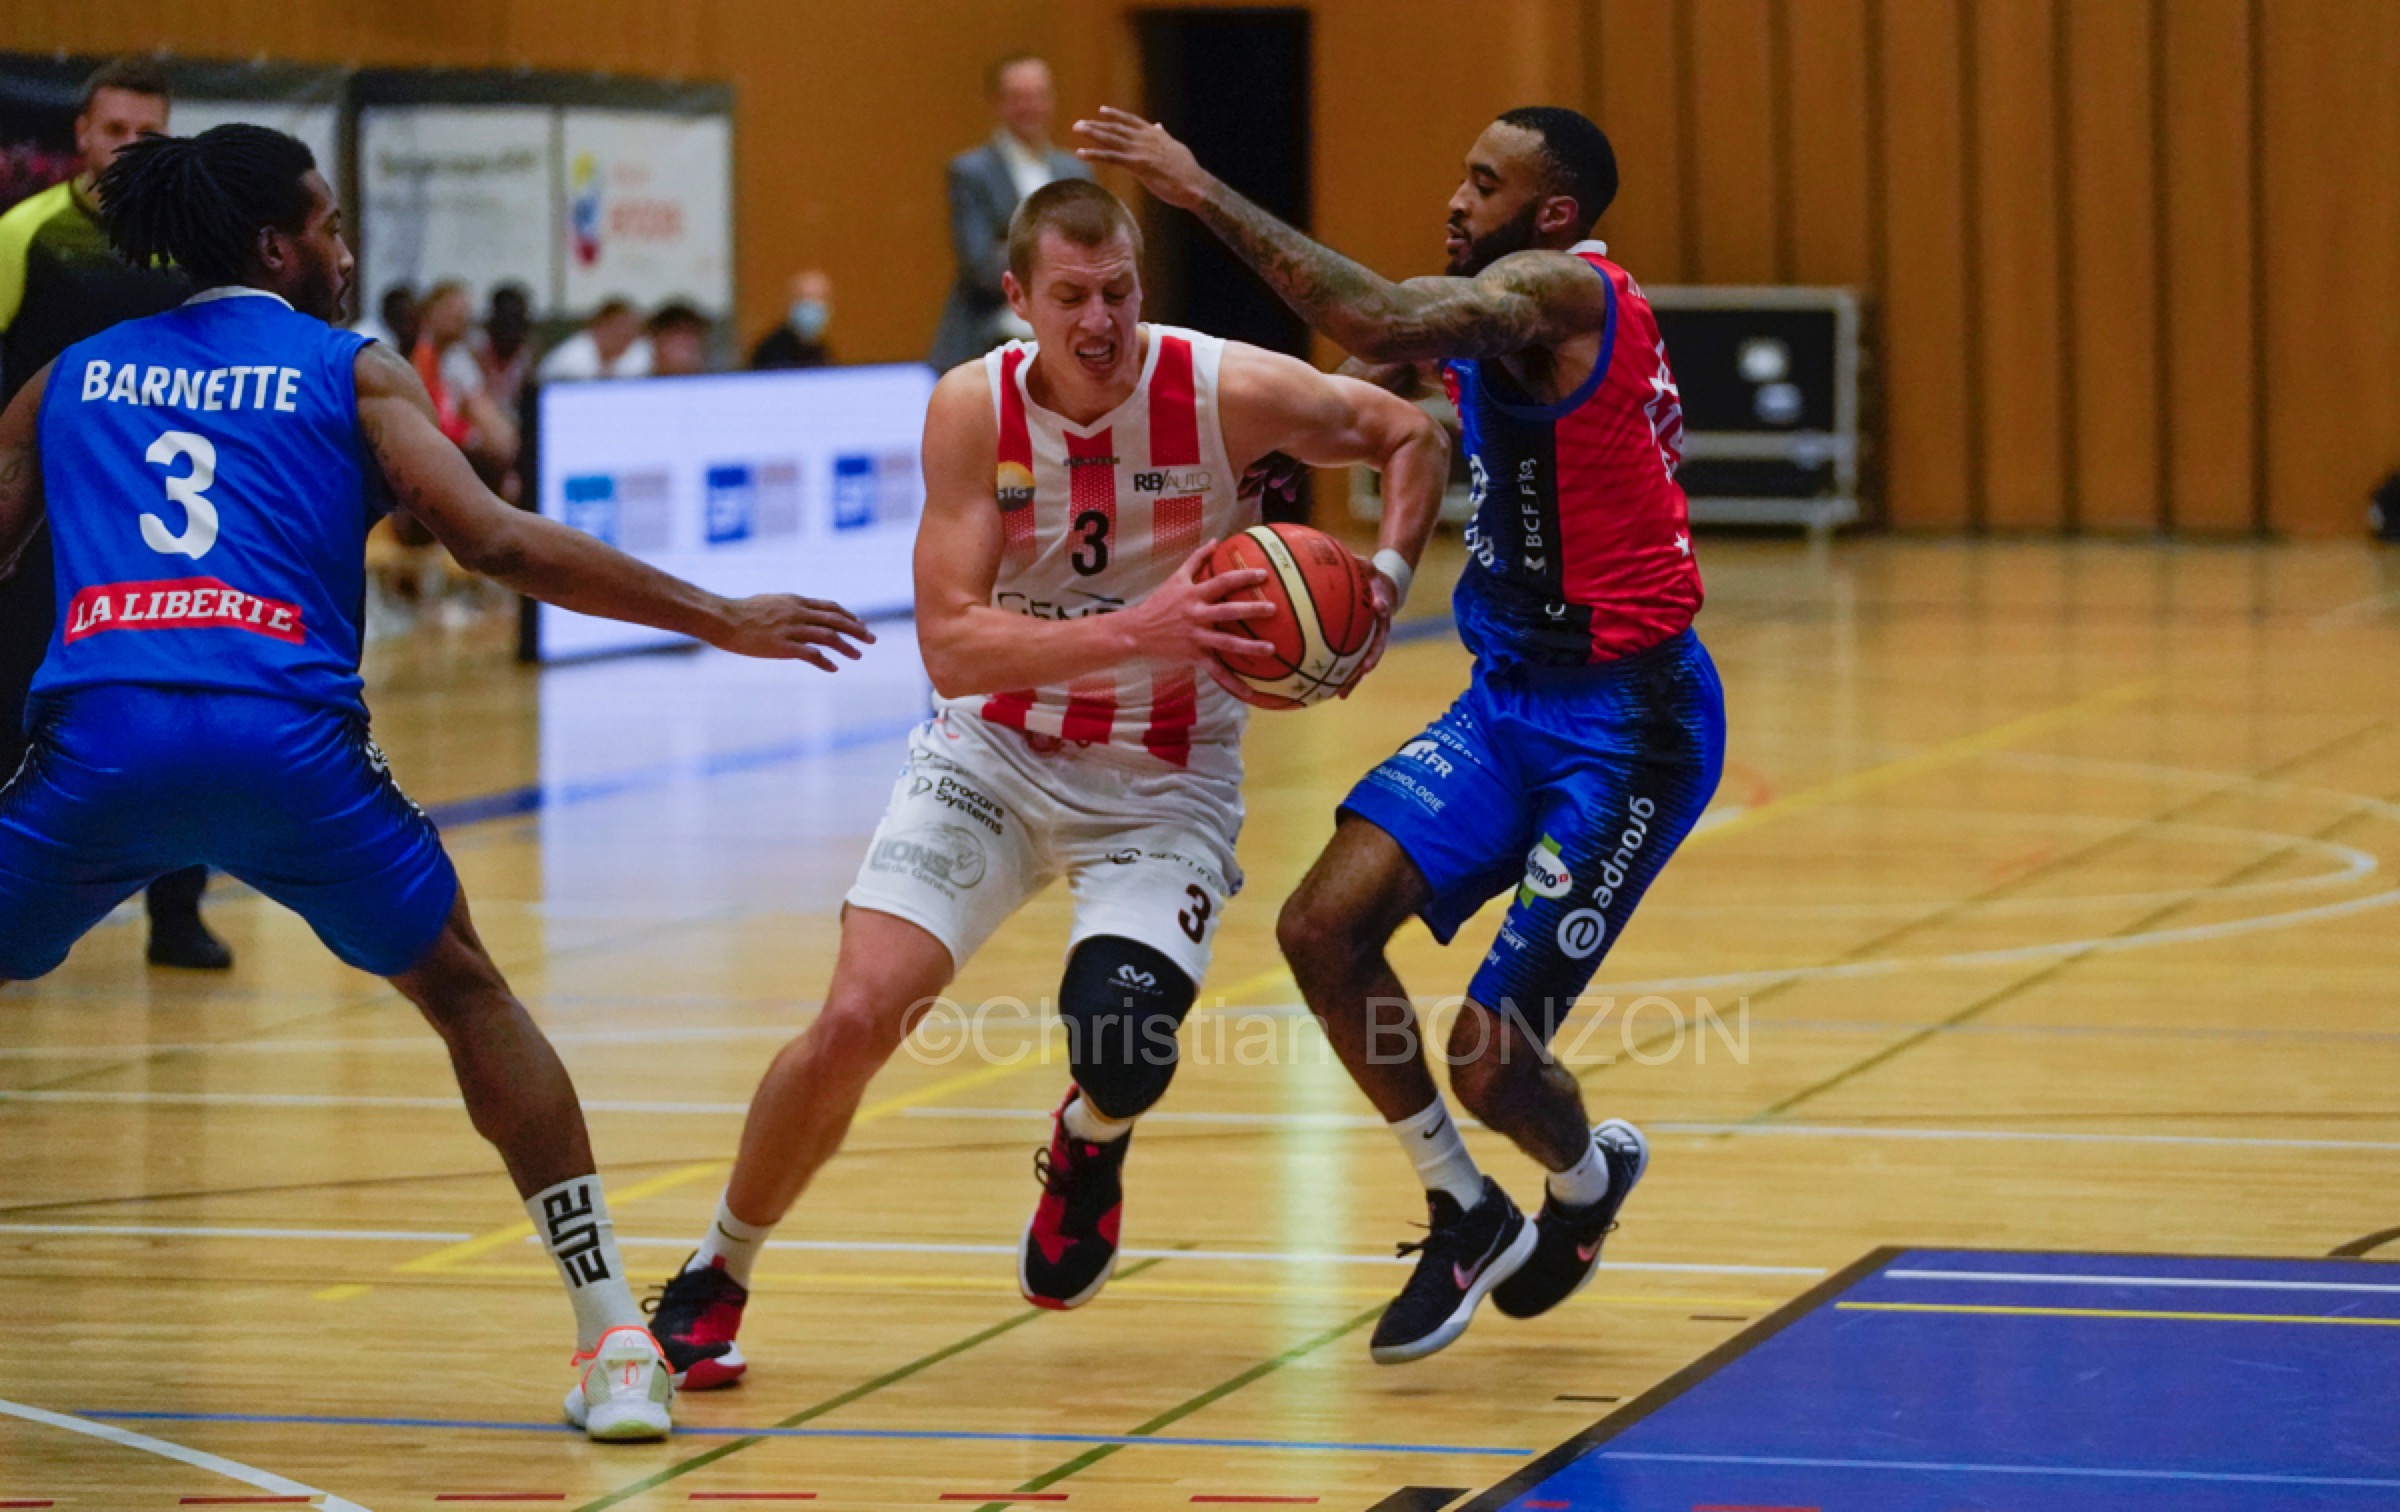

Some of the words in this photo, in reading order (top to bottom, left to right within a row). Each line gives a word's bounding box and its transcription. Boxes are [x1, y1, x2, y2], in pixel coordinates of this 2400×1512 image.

[82, 360, 302, 413] BARNETTE
[138, 430, 219, 560] 3
[1071, 509, 1109, 577] 3
[71, 596, 112, 632] LA
[1592, 795, 1655, 908] groupe
[1178, 883, 1212, 944] 3
